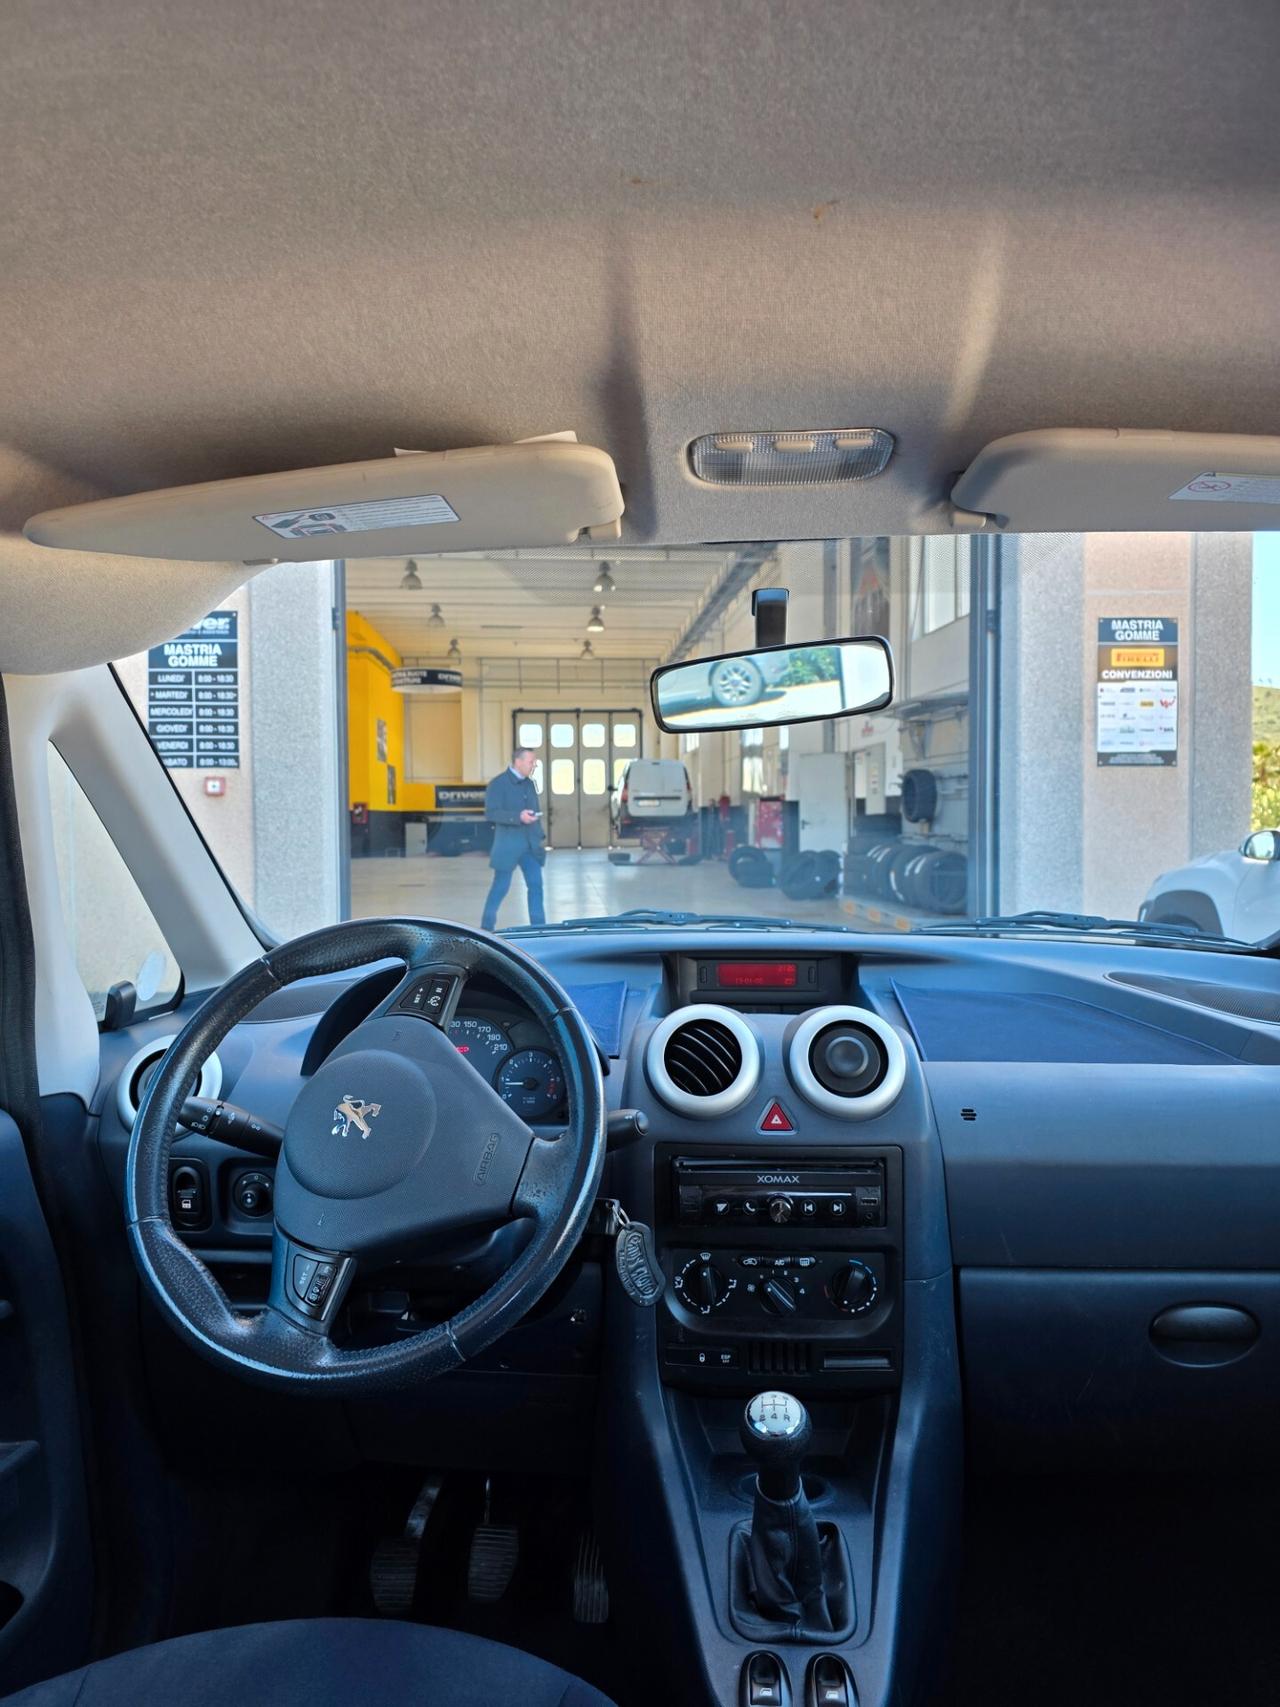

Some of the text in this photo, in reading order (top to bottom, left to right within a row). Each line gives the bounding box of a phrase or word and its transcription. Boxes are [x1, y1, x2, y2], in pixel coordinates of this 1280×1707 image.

[1112, 619, 1164, 631] MASTRIA
[1115, 630, 1161, 641] GOMME
[163, 643, 222, 656] MASTRIA
[168, 655, 218, 667] GOMME
[1102, 669, 1173, 679] CONVENZIONI
[494, 1043, 508, 1051] 210
[476, 1132, 499, 1182] AIRBAG
[756, 1175, 800, 1184] XOMAX
[771, 1412, 778, 1420] 4
[784, 1414, 791, 1422] R
